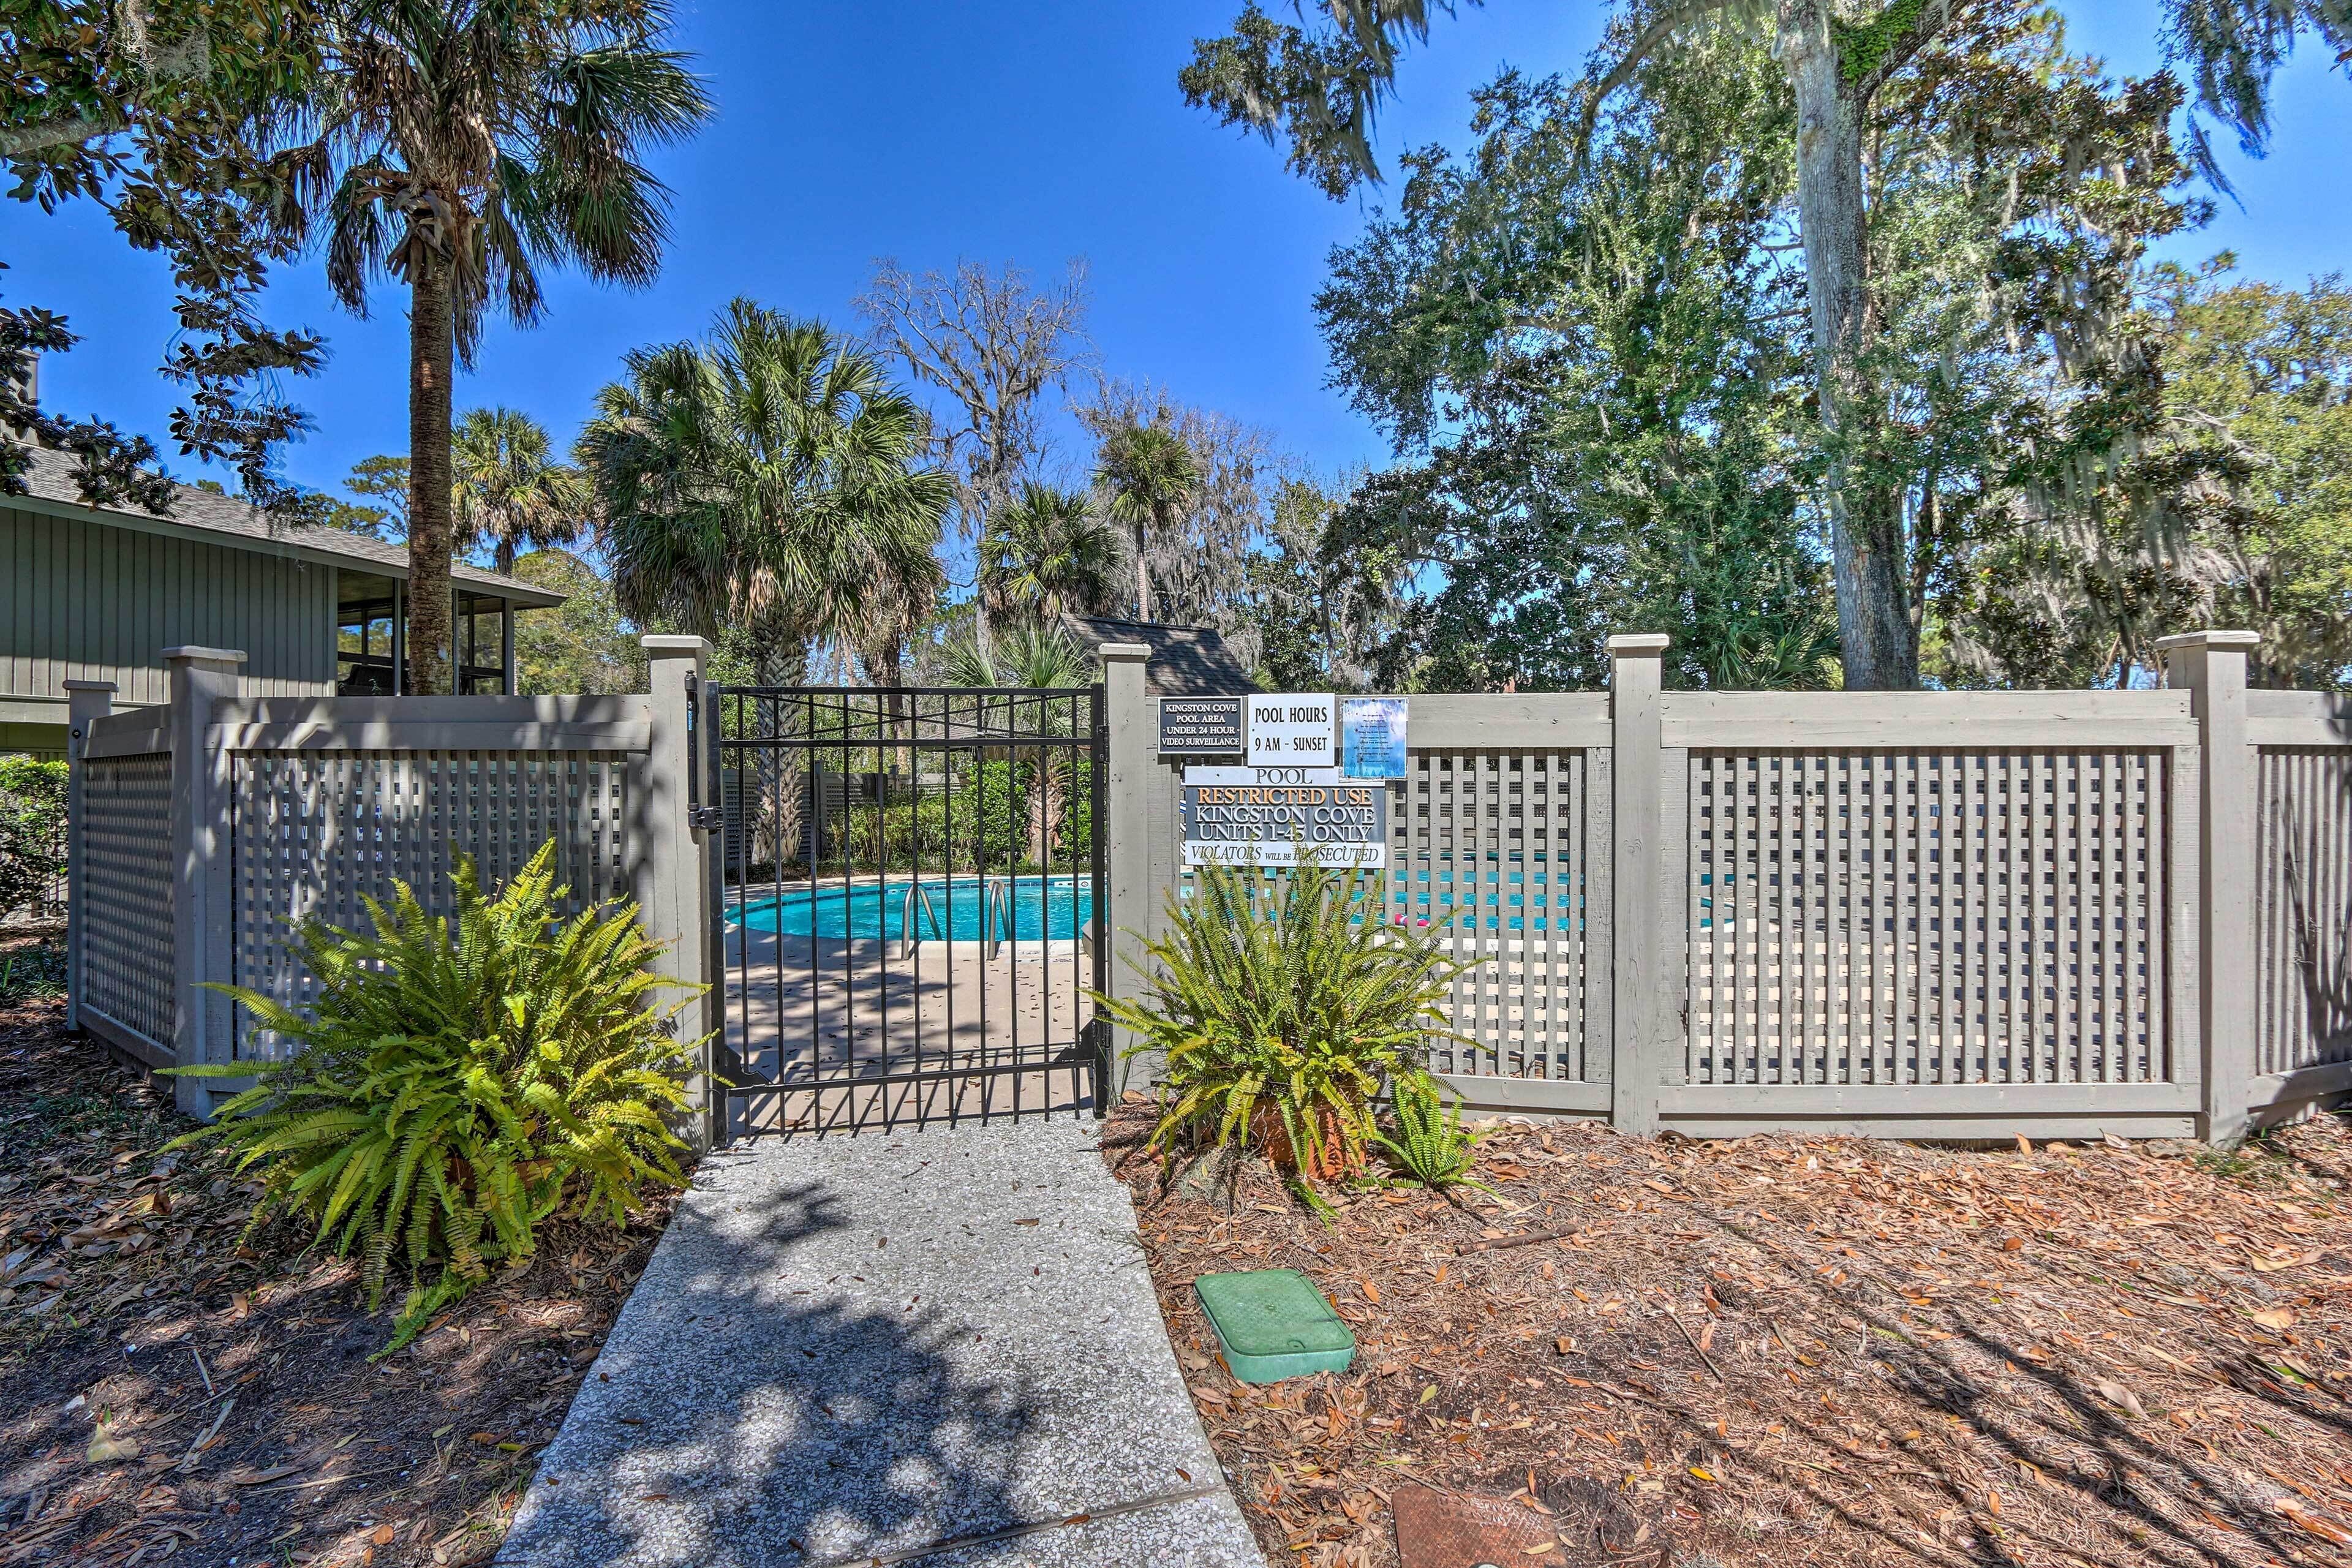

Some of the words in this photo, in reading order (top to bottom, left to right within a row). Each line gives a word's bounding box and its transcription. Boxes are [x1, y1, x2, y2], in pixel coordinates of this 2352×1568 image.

[1166, 704, 1211, 713] KINGSTON
[1212, 704, 1237, 713] COVE
[1255, 707, 1285, 723] POOL
[1289, 707, 1327, 723] HOURS
[1166, 726, 1197, 735] UNDER
[1210, 726, 1236, 735] HOUR
[1162, 737, 1185, 746] VIDEO
[1186, 737, 1240, 746] SURVEILLANCE
[1255, 737, 1261, 752] 9
[1265, 737, 1281, 751] AM
[1293, 737, 1327, 751] SUNSET
[1255, 769, 1313, 784] POOL
[1197, 788, 1327, 805] RESTRICTED
[1332, 788, 1373, 806] USE
[1195, 806, 1307, 824] KINGSTON
[1314, 807, 1375, 825] COVE
[1197, 824, 1263, 841] UNITS
[1269, 824, 1306, 842] 1-45
[1313, 825, 1373, 843] ONLY
[1191, 846, 1262, 860] VIOLATORS
[1293, 848, 1379, 862] POSECUTED
